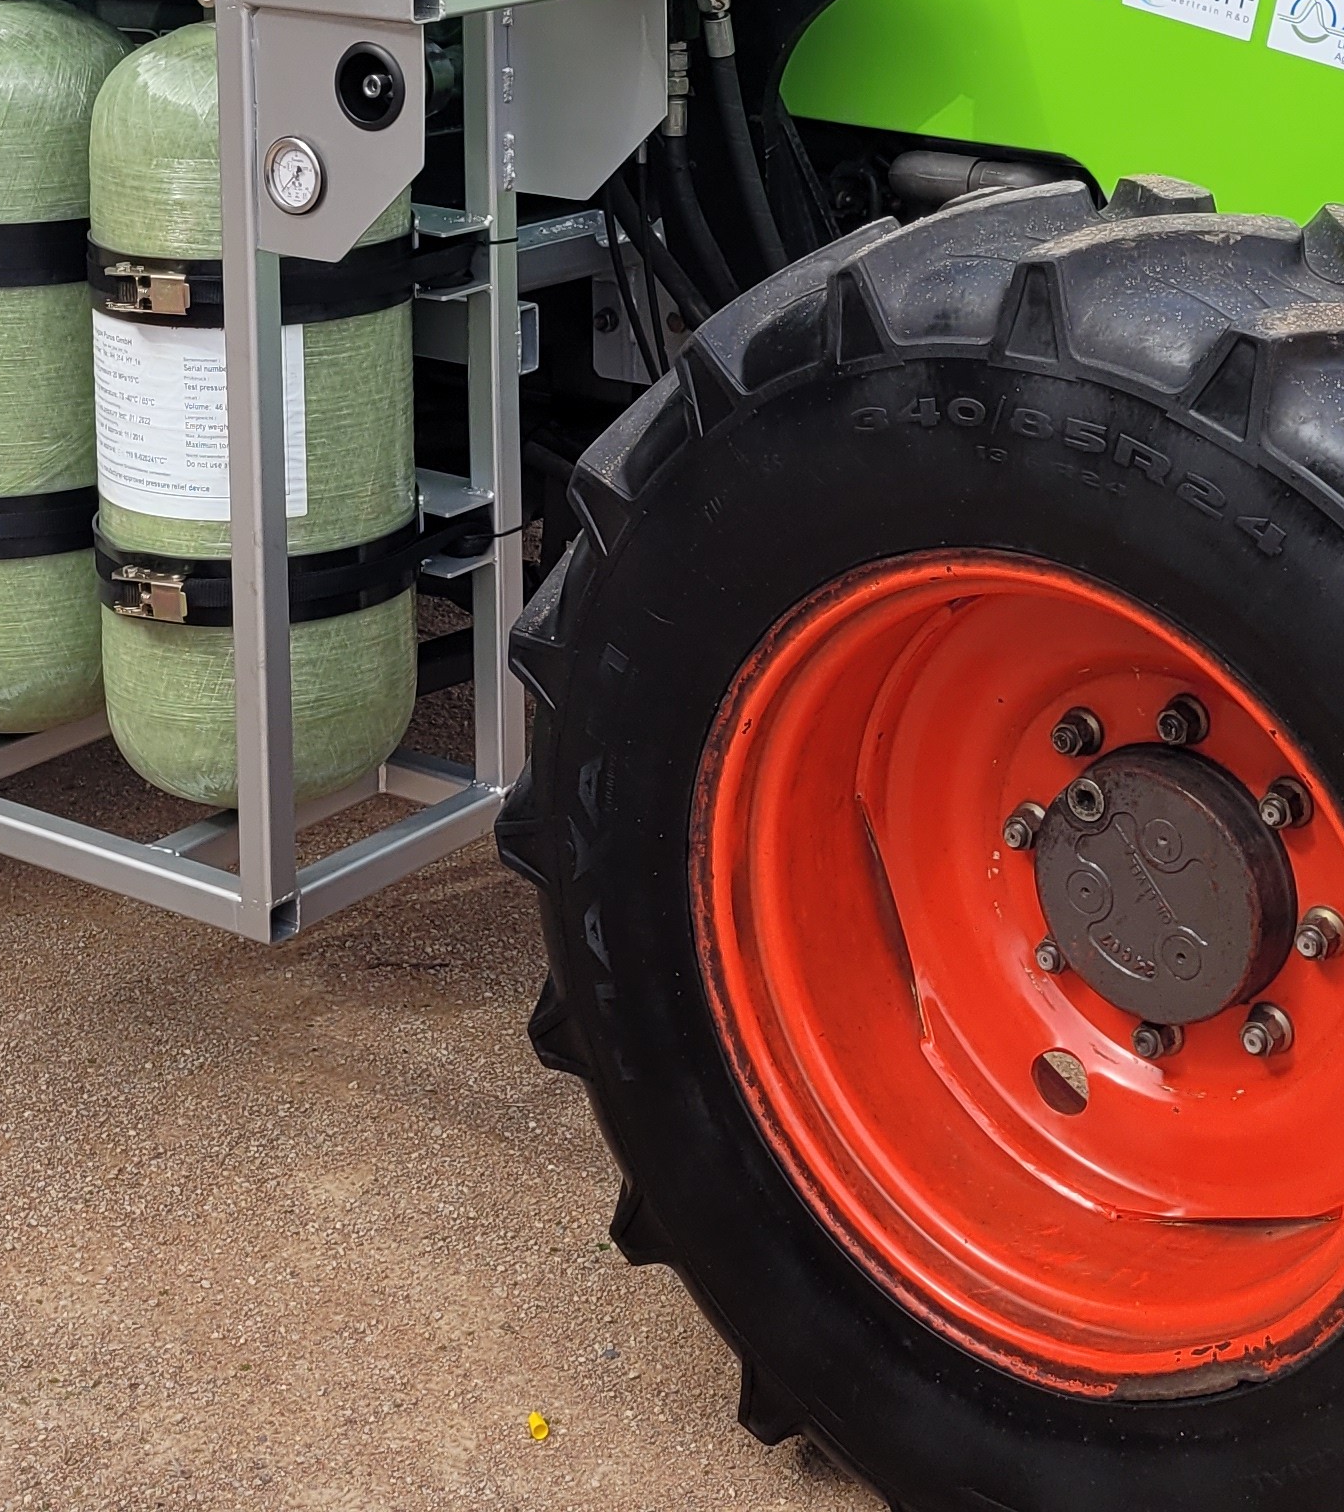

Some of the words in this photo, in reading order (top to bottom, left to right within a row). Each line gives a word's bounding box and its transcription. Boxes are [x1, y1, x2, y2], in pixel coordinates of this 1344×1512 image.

[1226, 9, 1250, 24] R&D
[183, 364, 202, 372] Serial
[184, 383, 197, 391] Test
[185, 422, 206, 432] Empty
[186, 441, 217, 449] Maximum
[850, 394, 1288, 557] 340/85R24
